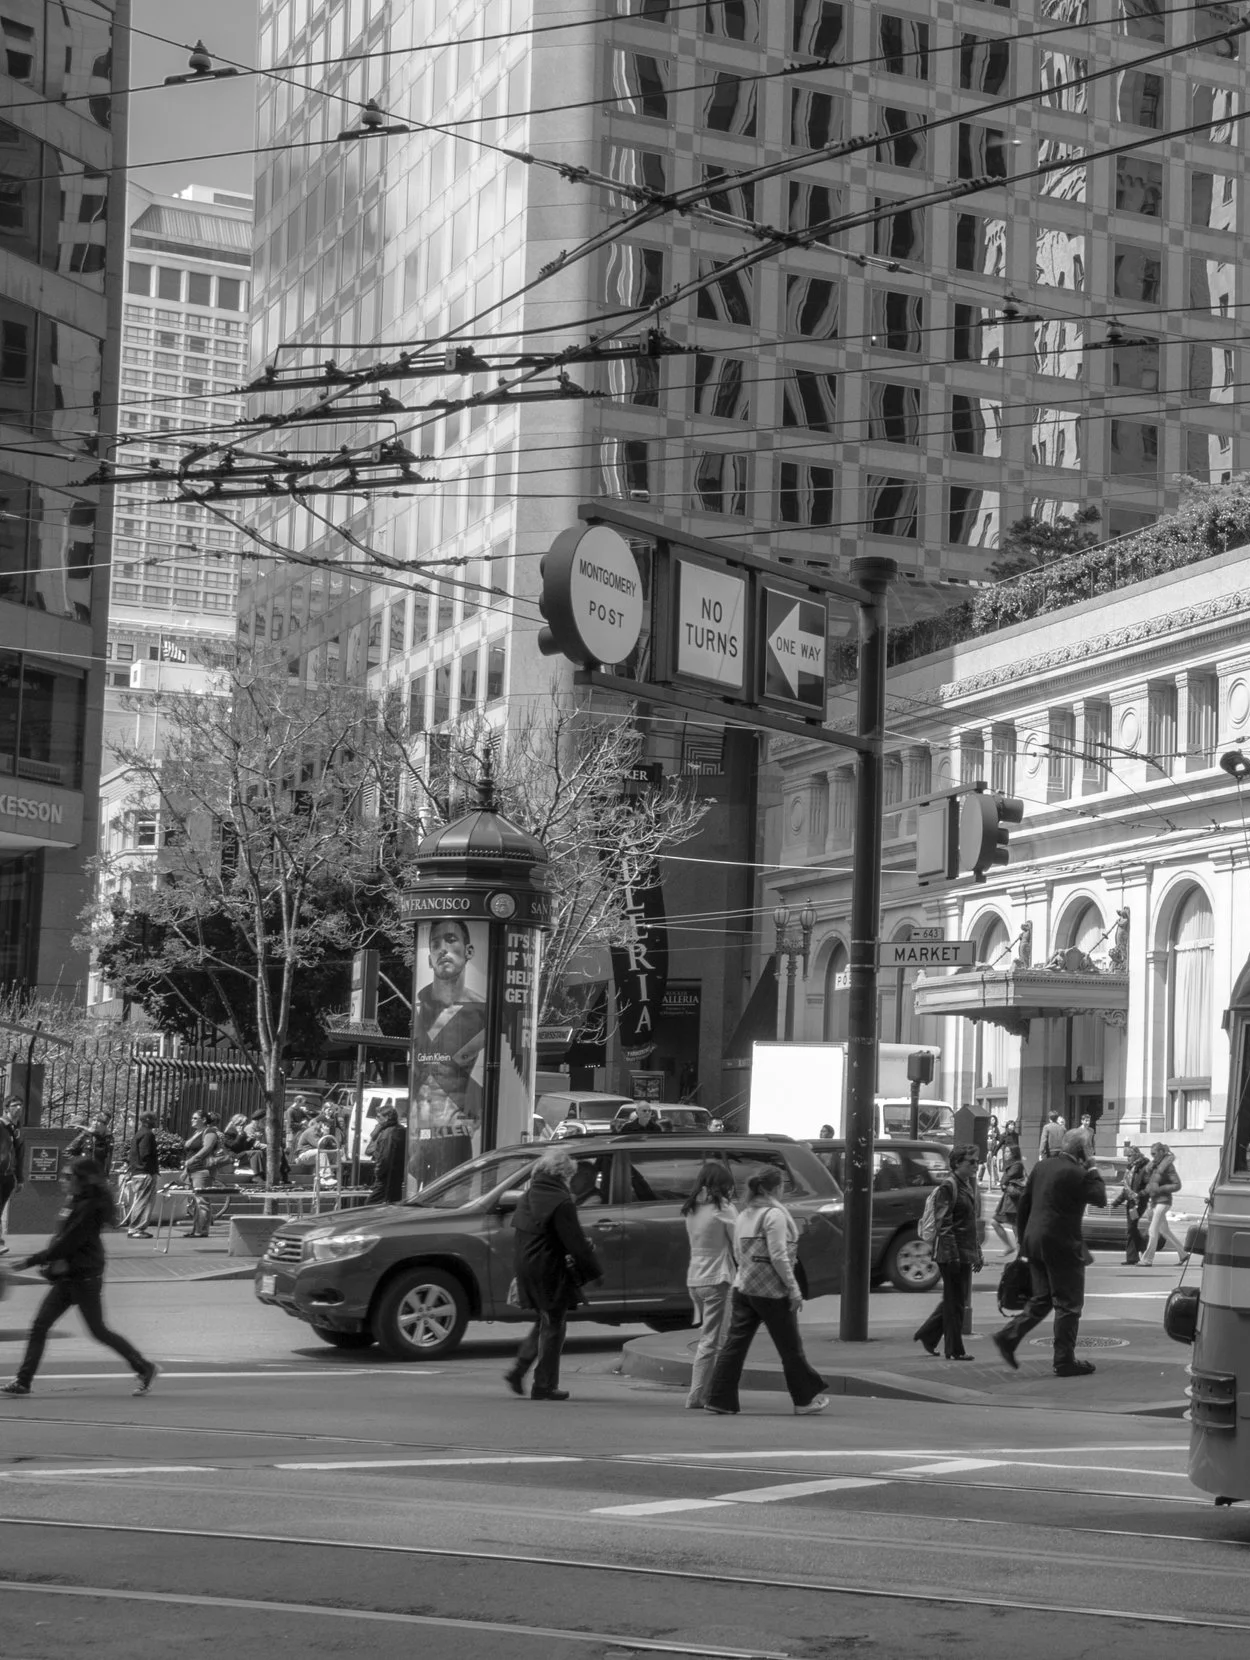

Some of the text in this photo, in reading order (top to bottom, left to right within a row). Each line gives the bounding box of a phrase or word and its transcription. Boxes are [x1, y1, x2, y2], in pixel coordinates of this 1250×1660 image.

[580, 559, 636, 597] MONTGOMERY
[589, 600, 624, 628] POST
[701, 597, 722, 623] NO
[685, 622, 738, 658] TURNS
[776, 636, 821, 662] ONE WAY
[410, 898, 470, 911] FRANCISCO
[508, 933, 529, 949] IT'S
[923, 929, 939, 939] 643
[507, 952, 535, 968] IF YO
[894, 946, 960, 962] MARKET
[837, 974, 852, 987] PO
[505, 988, 528, 1004] GET
[417, 1053, 451, 1062] Calvin Klein
